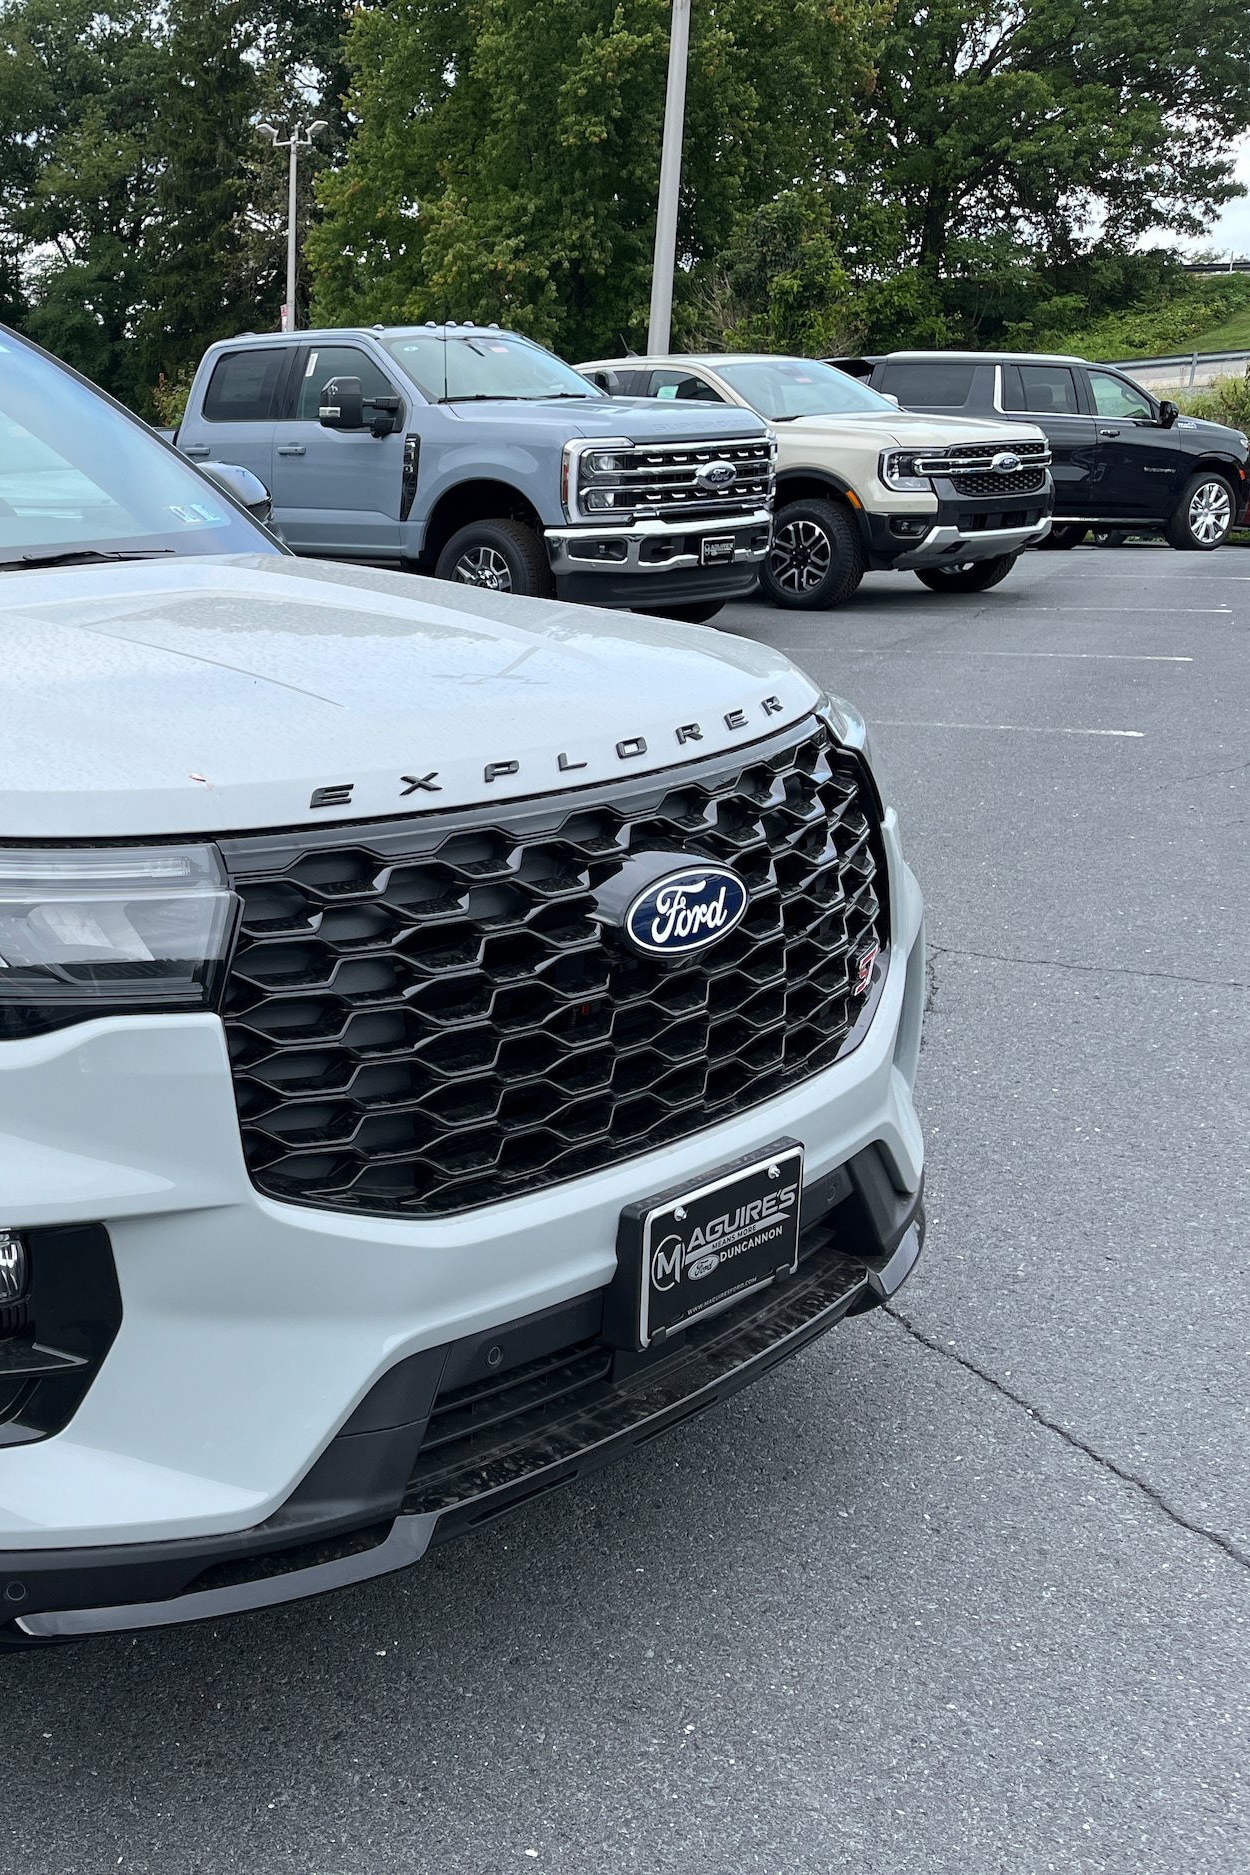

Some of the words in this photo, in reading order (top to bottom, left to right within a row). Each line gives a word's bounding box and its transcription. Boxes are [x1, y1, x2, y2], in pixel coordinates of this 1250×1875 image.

[710, 468, 730, 481] Ford
[310, 695, 784, 808] EXPLORER
[651, 879, 728, 943] Ford
[711, 1235, 736, 1250] MEANS
[736, 1225, 757, 1238] MORE
[720, 1225, 783, 1262] DUNCANNON
